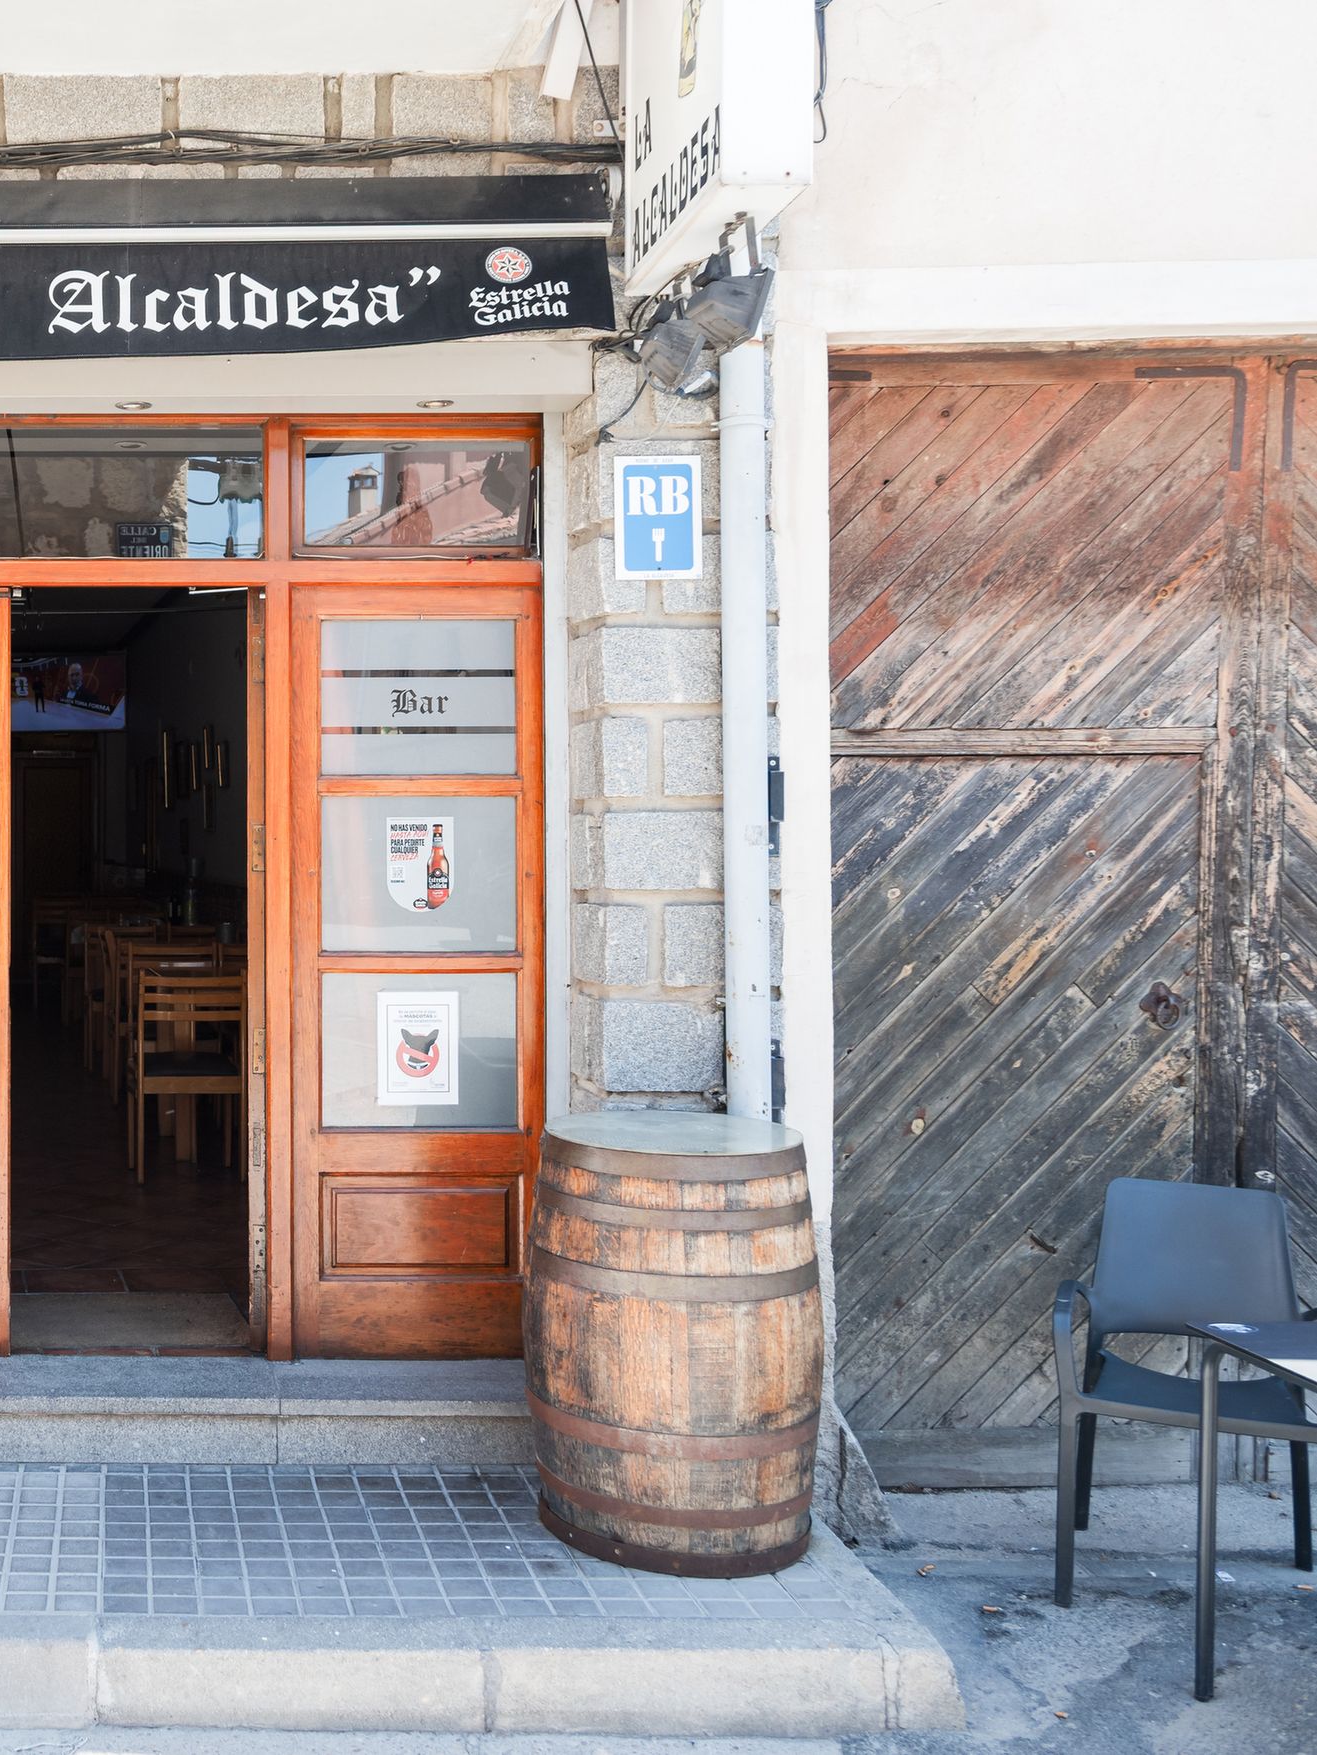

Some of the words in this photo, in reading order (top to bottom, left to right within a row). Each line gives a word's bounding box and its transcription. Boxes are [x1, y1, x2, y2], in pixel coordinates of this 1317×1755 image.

[634, 97, 653, 172] LA
[631, 104, 722, 269] ALCALDESA
[468, 280, 571, 308] Estrella
[474, 296, 569, 326] Galicia
[626, 475, 690, 516] RB
[390, 689, 449, 717] Bar
[390, 824, 398, 832] NO
[398, 824, 409, 832] HAS
[409, 824, 428, 832] VENIDO
[391, 846, 419, 854] CUALQUIER
